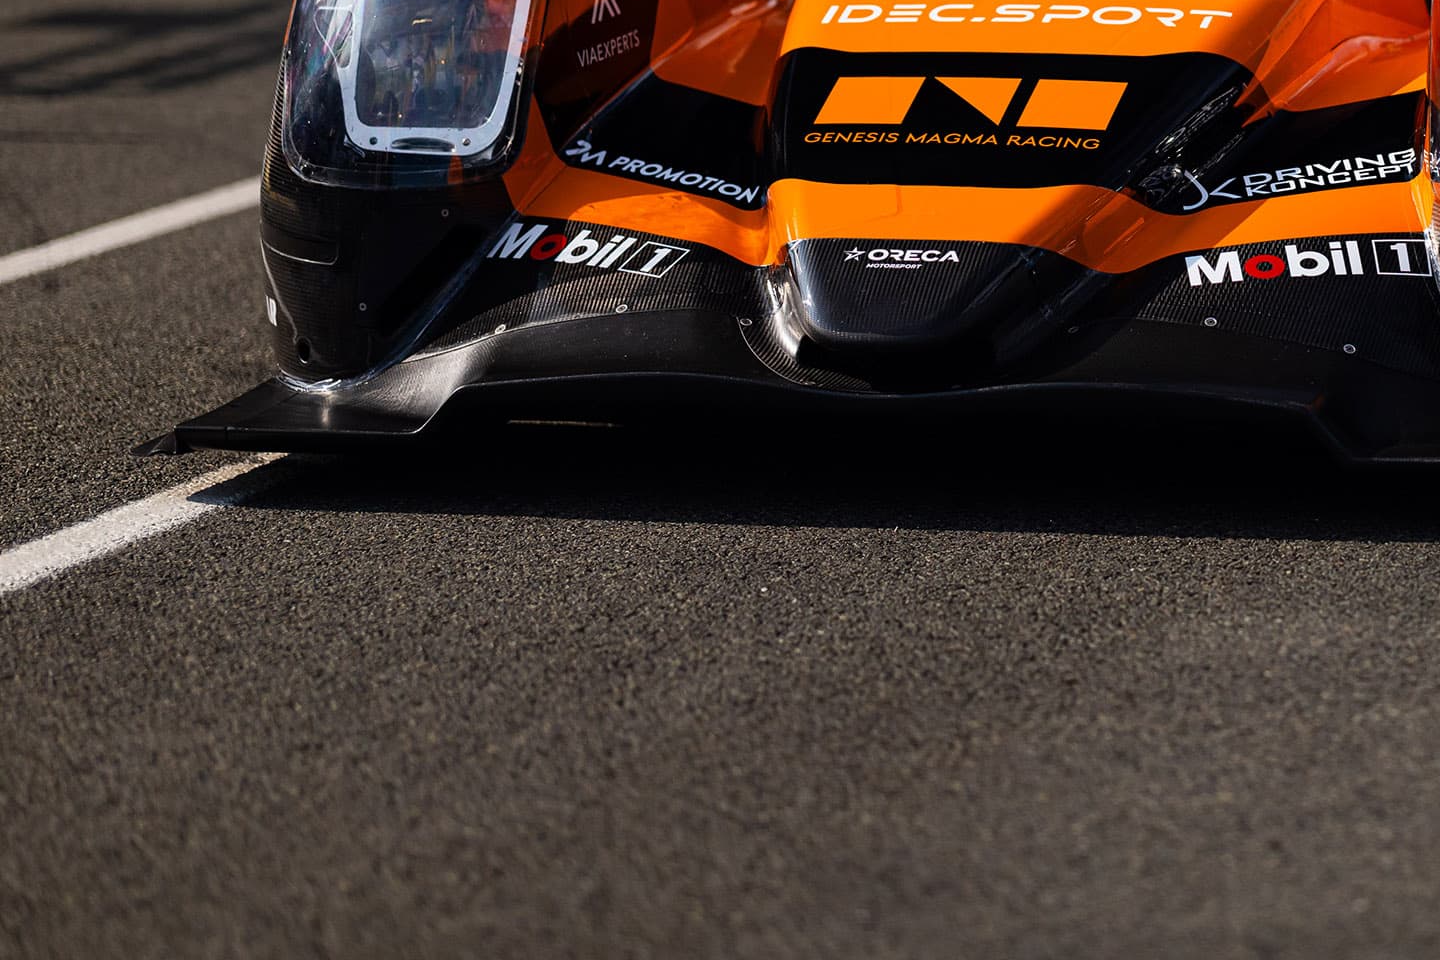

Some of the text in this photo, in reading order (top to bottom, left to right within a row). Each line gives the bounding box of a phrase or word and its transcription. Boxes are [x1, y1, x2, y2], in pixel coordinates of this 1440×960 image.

[820, 3, 1233, 29] IDEC.SPORT
[576, 28, 641, 68] VIAEXPERTS
[804, 131, 1101, 150] GENESIS MAGMA RACING
[608, 155, 760, 204] PROMOTION
[1243, 147, 1417, 187] DRIVING
[1246, 162, 1414, 198] KONCEPT
[486, 222, 673, 273] Mobil 1
[867, 248, 960, 263] ORECA
[1184, 240, 1412, 287] Mobil 1
